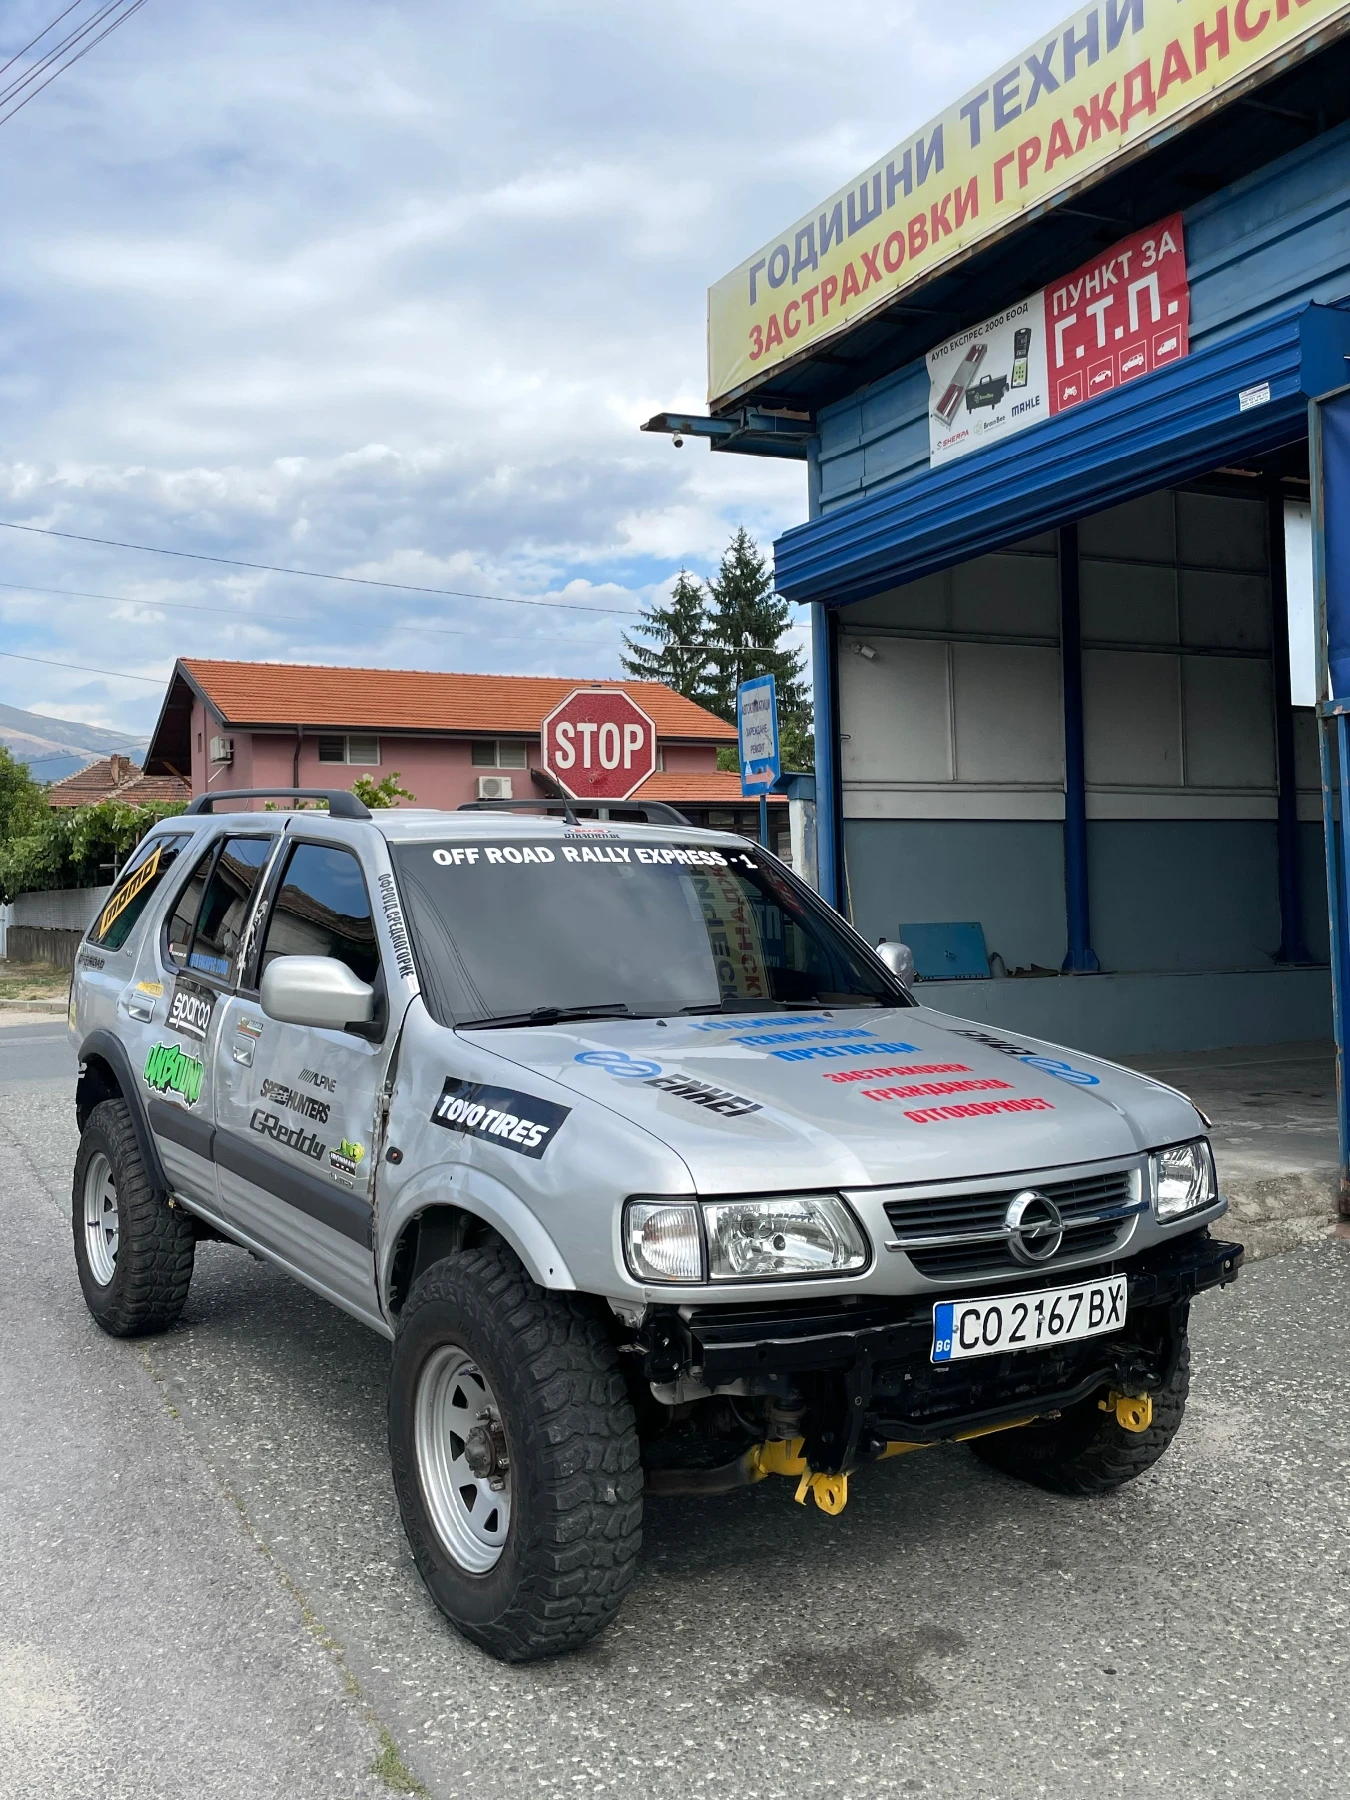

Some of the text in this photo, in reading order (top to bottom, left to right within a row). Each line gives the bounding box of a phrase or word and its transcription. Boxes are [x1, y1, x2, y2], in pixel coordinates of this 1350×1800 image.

[749, 0, 1185, 306] ГОДИШНИ ТЕХНИ
[748, 175, 979, 361] ЗАСТРАХОВКИ
[1053, 231, 1177, 316] ПУНКТ ЗА
[931, 302, 1028, 363] АУТО ЕКСПРЕС 2000 ЕООД
[1054, 271, 1178, 369] Г.Т.П.
[1011, 395, 1040, 417] MAHLE
[942, 429, 969, 447] SHERPA
[555, 721, 645, 770] STOP
[432, 848, 480, 866] OFF
[485, 846, 556, 865] ROAD
[561, 846, 631, 863] RALLY
[633, 848, 729, 867] EXPRESS
[386, 911, 415, 979] СРЕДНОГОРИЕ
[728, 1028, 881, 1046] ТЕХНИЧЕСКИ
[769, 1042, 924, 1062] ПРЕГЛЕДИ
[643, 1073, 764, 1118] ENKEI
[822, 1063, 975, 1083] ЗАСТРАХОВКИ
[859, 1079, 1016, 1103] ГРАЖДАНСКА
[438, 1095, 550, 1147] TOYO TIRES
[902, 1097, 1058, 1125] ОТГОВОРНОСТ
[959, 1283, 1122, 1350] CO 2167 BX
[935, 1339, 950, 1353] BG
